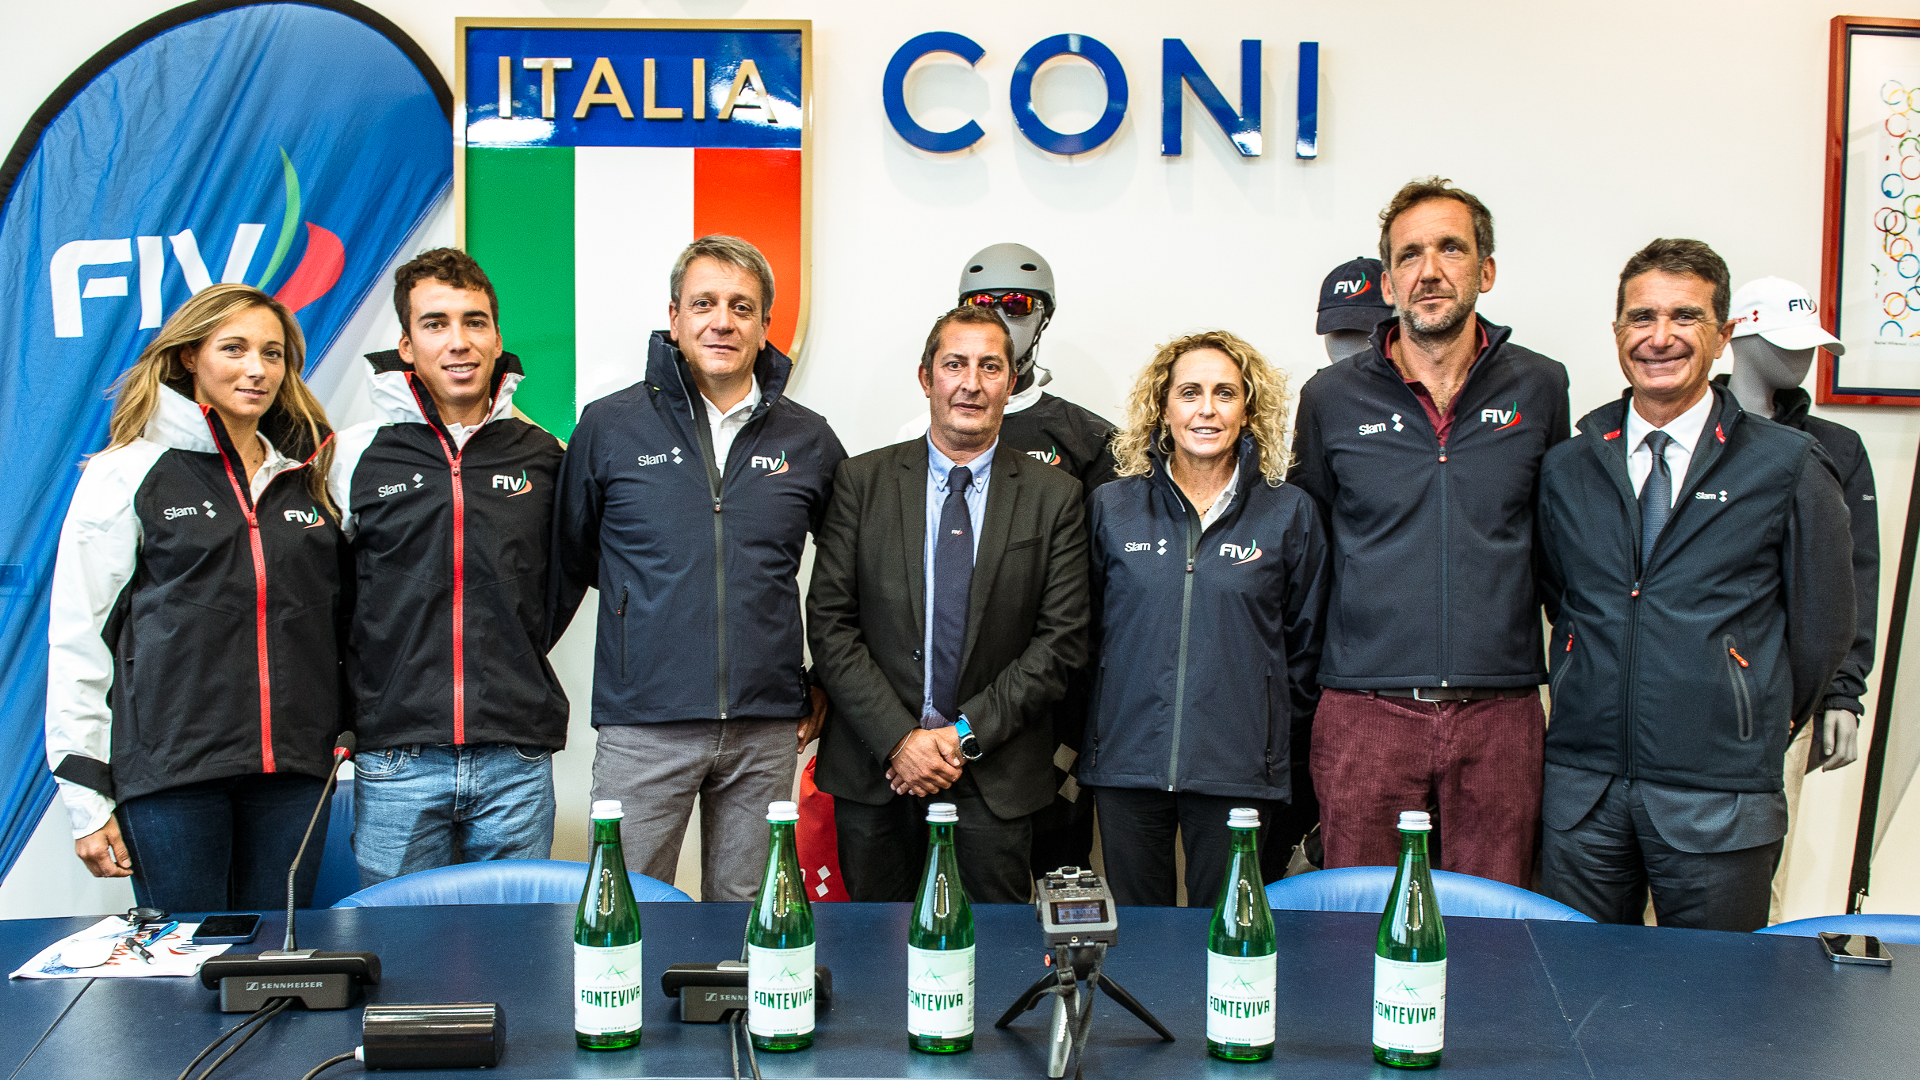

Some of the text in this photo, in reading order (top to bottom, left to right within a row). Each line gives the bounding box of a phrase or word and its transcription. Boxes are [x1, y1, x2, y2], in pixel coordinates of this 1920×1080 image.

[498, 56, 778, 123] ITALIA
[882, 31, 1318, 160] CONI
[50, 223, 266, 338] FIV
[1333, 280, 1362, 295] FIV
[1788, 298, 1813, 312] FIV
[1480, 408, 1512, 425] FIV
[1358, 422, 1387, 436] Slam
[637, 453, 667, 467] Slam
[751, 455, 781, 471] FIV
[377, 482, 407, 498] Slam
[491, 474, 522, 492] FIV
[1695, 491, 1717, 500] Slam
[163, 506, 198, 520] Slam
[283, 510, 314, 524] FIV
[1124, 541, 1151, 552] Slam
[1219, 543, 1251, 560] FIV
[261, 981, 323, 989] SENNHEISER
[581, 985, 640, 1009] FONTEVIVA
[754, 988, 813, 1010] FONTEVIVA
[1209, 995, 1270, 1019] FONTEVIVA
